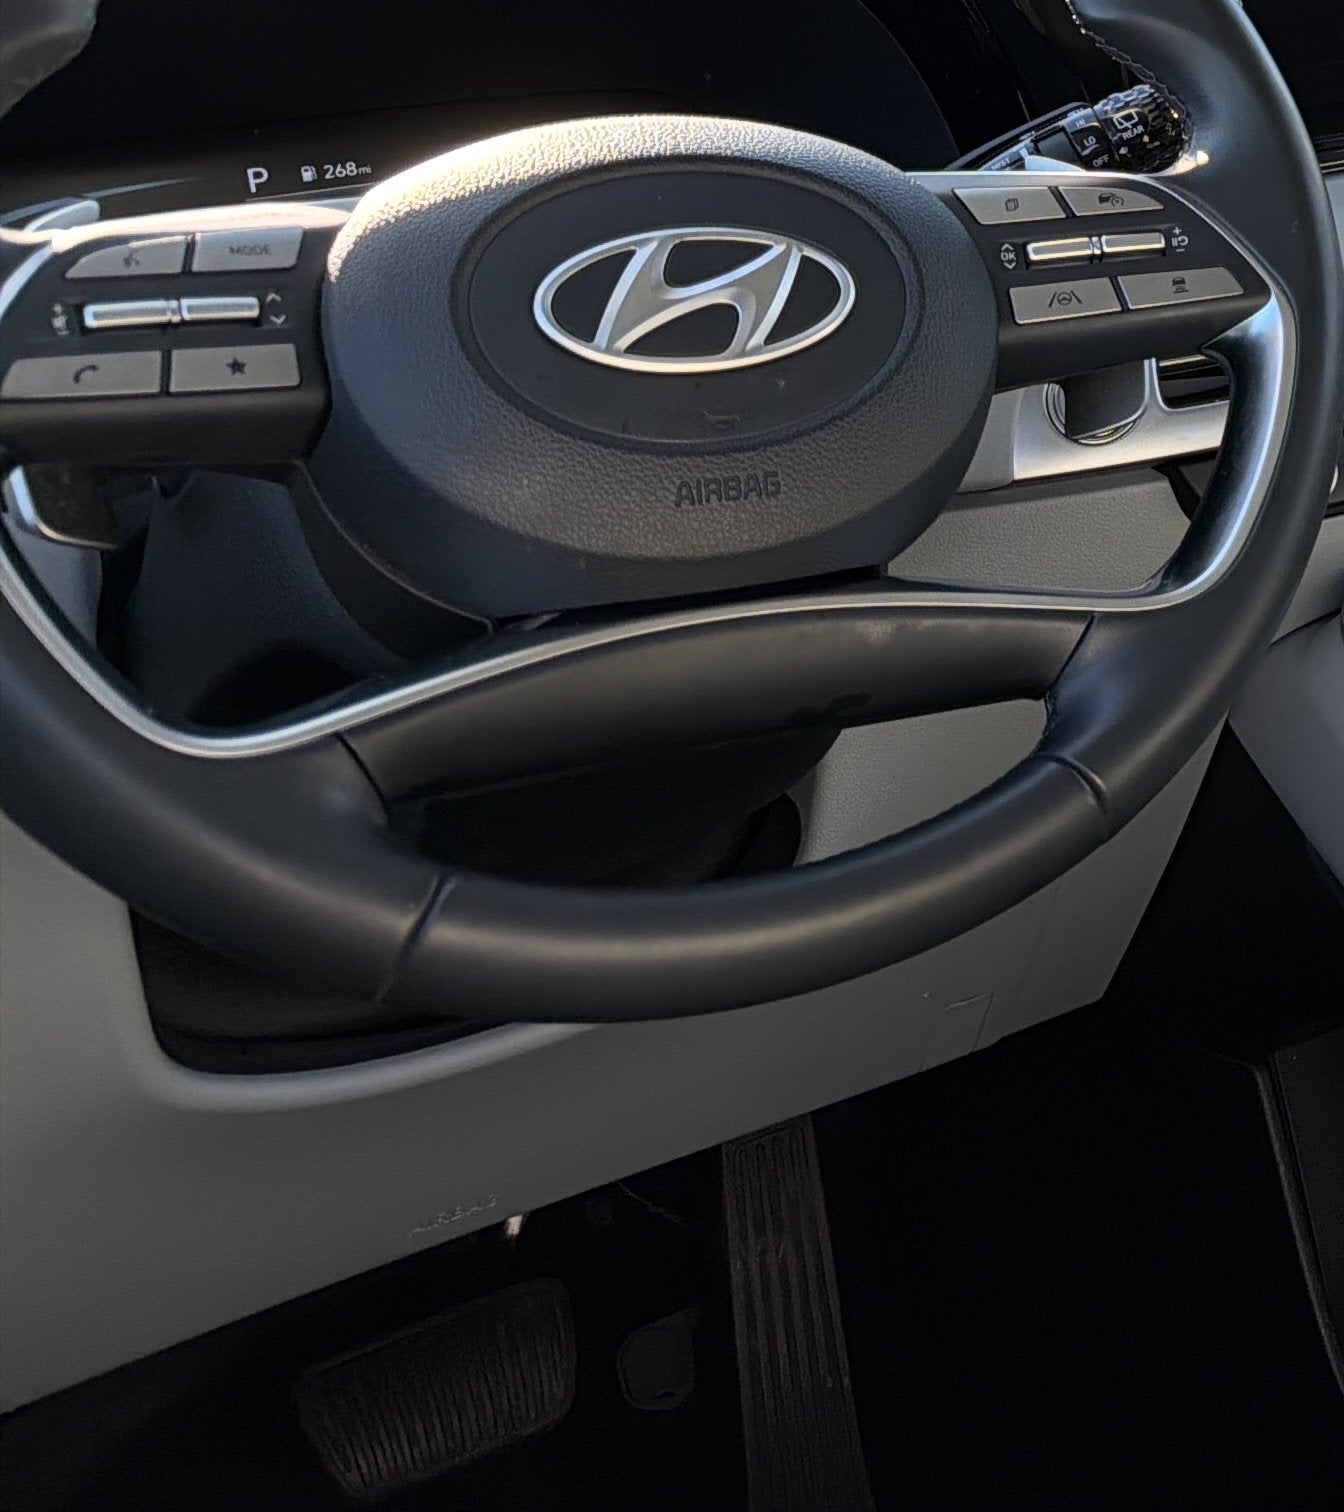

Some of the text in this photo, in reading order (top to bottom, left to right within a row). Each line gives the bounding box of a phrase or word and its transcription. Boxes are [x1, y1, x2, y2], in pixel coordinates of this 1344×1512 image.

[1122, 125, 1145, 141] REAR
[1084, 135, 1097, 146] LO
[1092, 154, 1110, 168] OFF
[246, 167, 269, 194] P
[228, 244, 271, 256] MODE
[1000, 251, 1017, 261] OK
[675, 470, 782, 508] AIRBAG
